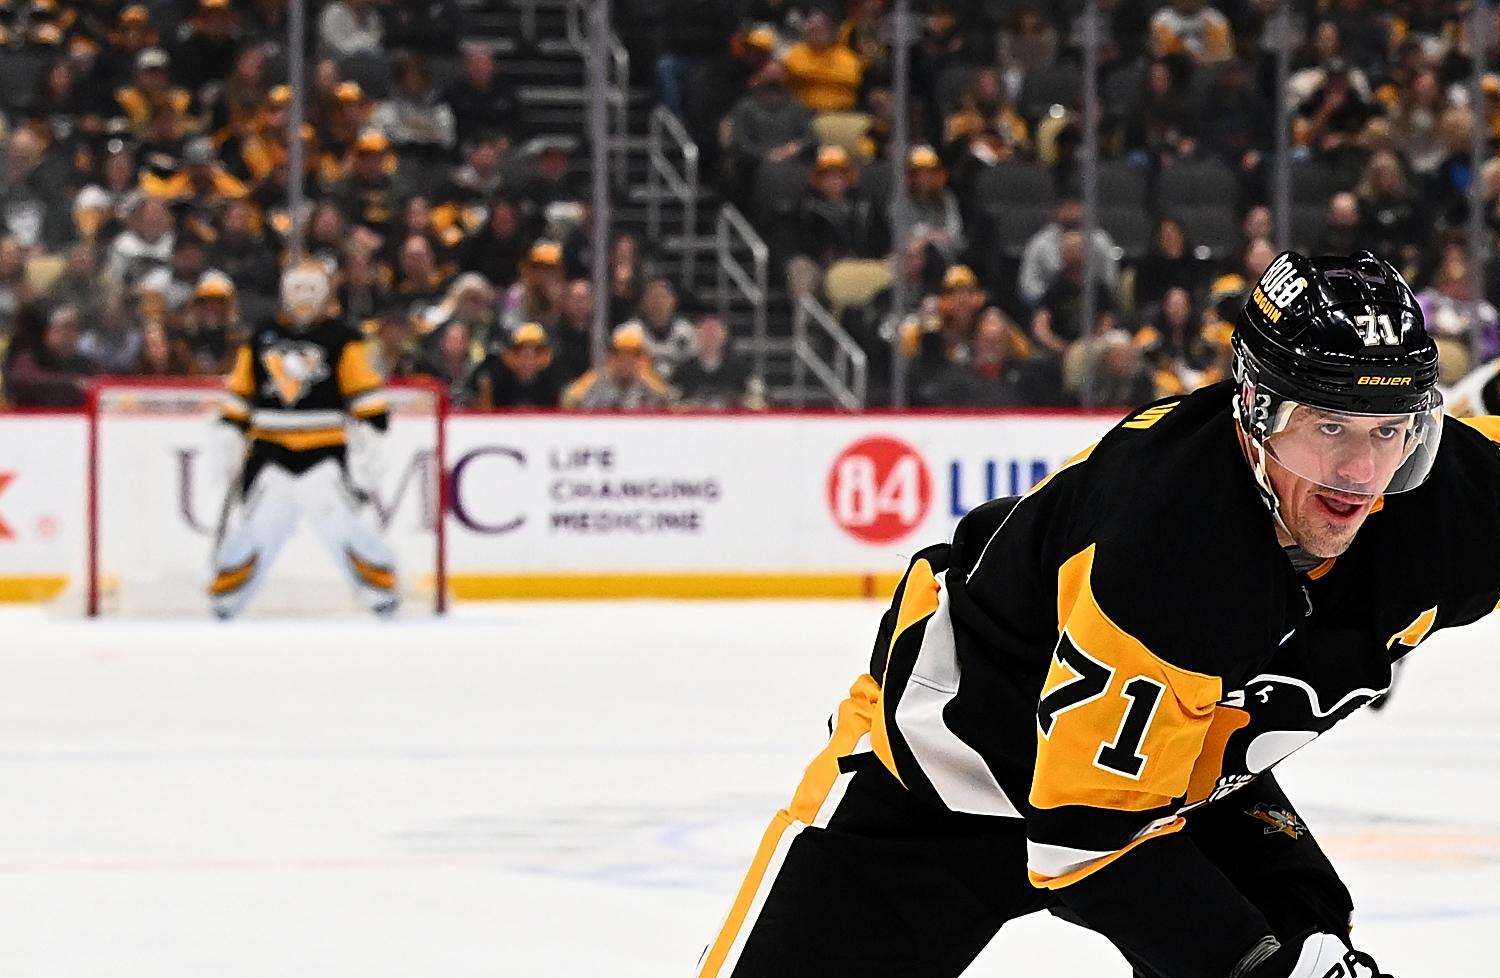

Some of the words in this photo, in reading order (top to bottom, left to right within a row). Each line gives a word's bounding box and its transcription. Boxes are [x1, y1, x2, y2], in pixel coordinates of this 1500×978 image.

[1354, 314, 1400, 347] 71
[838, 454, 922, 528] 84
[1036, 624, 1167, 781] 71
